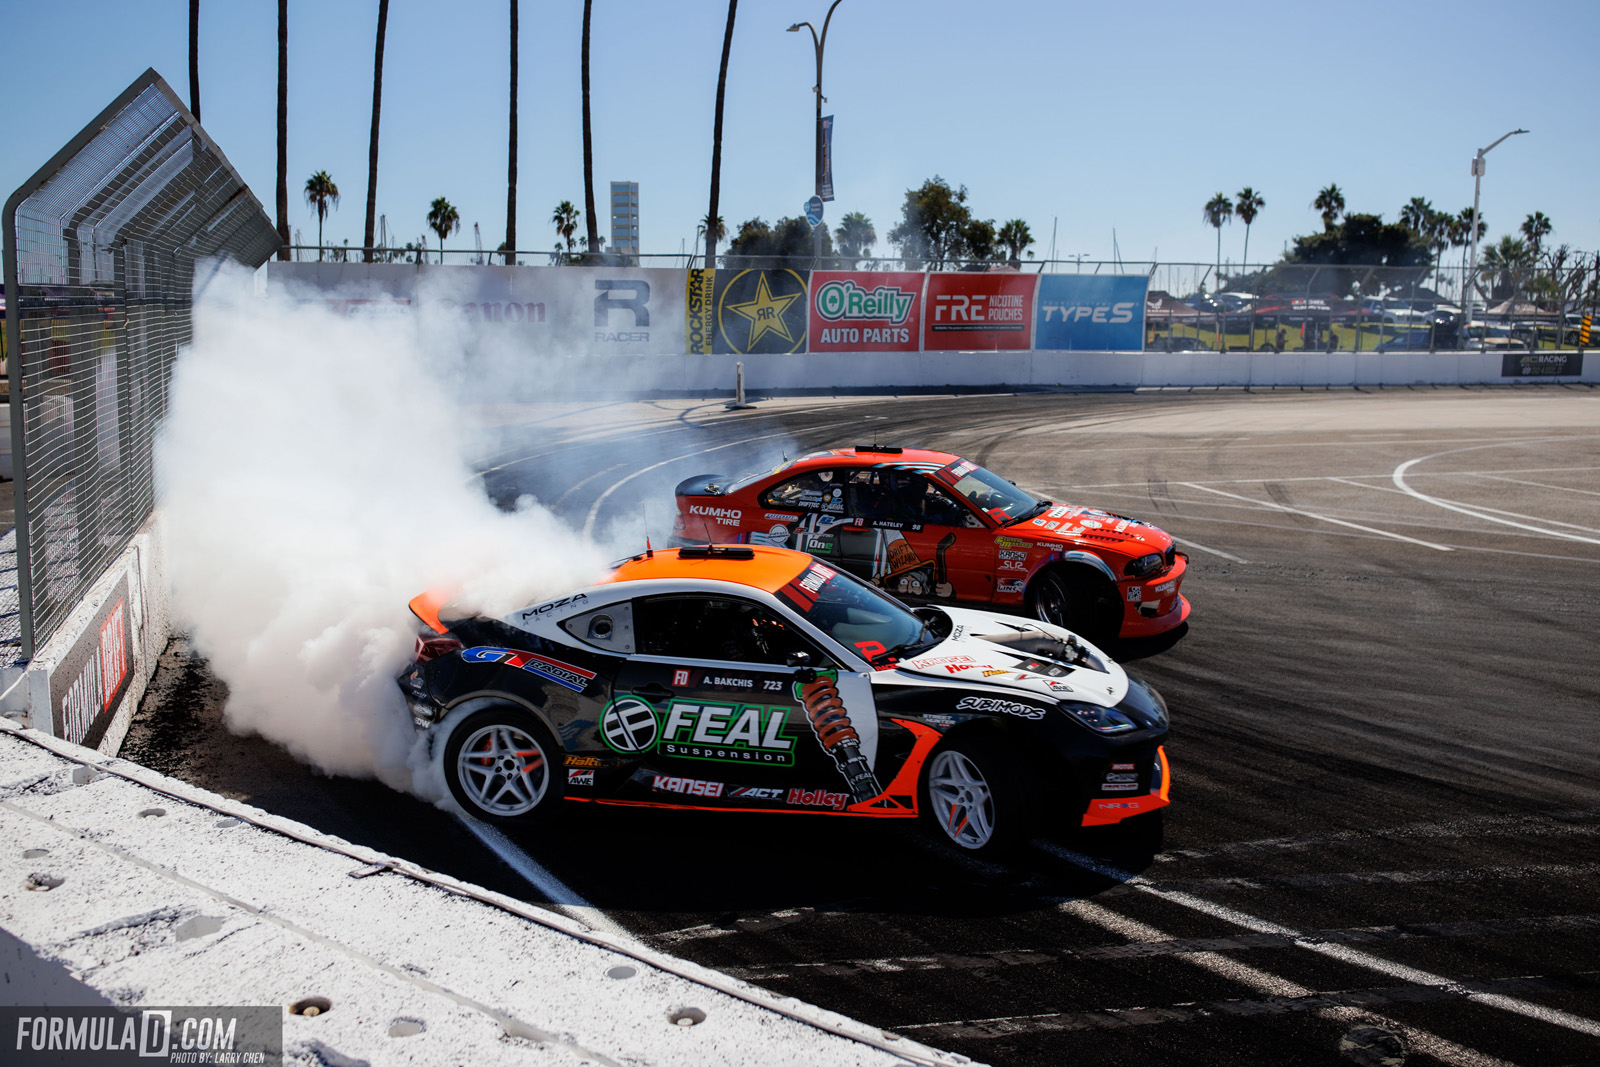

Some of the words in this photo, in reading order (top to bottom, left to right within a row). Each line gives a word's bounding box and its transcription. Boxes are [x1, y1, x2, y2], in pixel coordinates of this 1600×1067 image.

[704, 275, 714, 306] DRINK
[818, 281, 915, 322] O'Reilly
[935, 295, 986, 321] FRE
[988, 295, 1024, 307] NICOTINE
[689, 268, 706, 355] ROCKSTAR
[988, 308, 1023, 321] POUCHES
[704, 308, 713, 346] ENERGY
[820, 327, 859, 344] AUTO
[862, 327, 910, 344] PARTS
[594, 332, 650, 342] RACER
[689, 504, 742, 519] KUMHO
[715, 517, 741, 527] TIRE
[809, 539, 833, 550] One
[888, 543, 909, 559] DRIFT
[1036, 541, 1064, 549] KUMHO
[890, 551, 917, 569] WIZARD
[1154, 580, 1175, 593] KUMHO
[521, 592, 588, 620] MOZA
[522, 599, 589, 627] RACING
[951, 624, 965, 642] MOZA
[61, 645, 104, 746] FORMULA
[101, 604, 126, 705] DRIFT
[523, 658, 589, 687] RADIAL
[674, 669, 690, 686] FD
[703, 676, 713, 685] A.
[714, 677, 754, 688] BAKCHIS
[763, 680, 783, 691] 723
[956, 696, 1047, 720] SUBIMODS
[662, 703, 793, 750] FEAL
[666, 744, 787, 763] Suspension
[569, 777, 593, 786] AWE
[855, 772, 872, 781] FEAL
[652, 775, 724, 797] KANSEI
[786, 788, 849, 811] Holley
